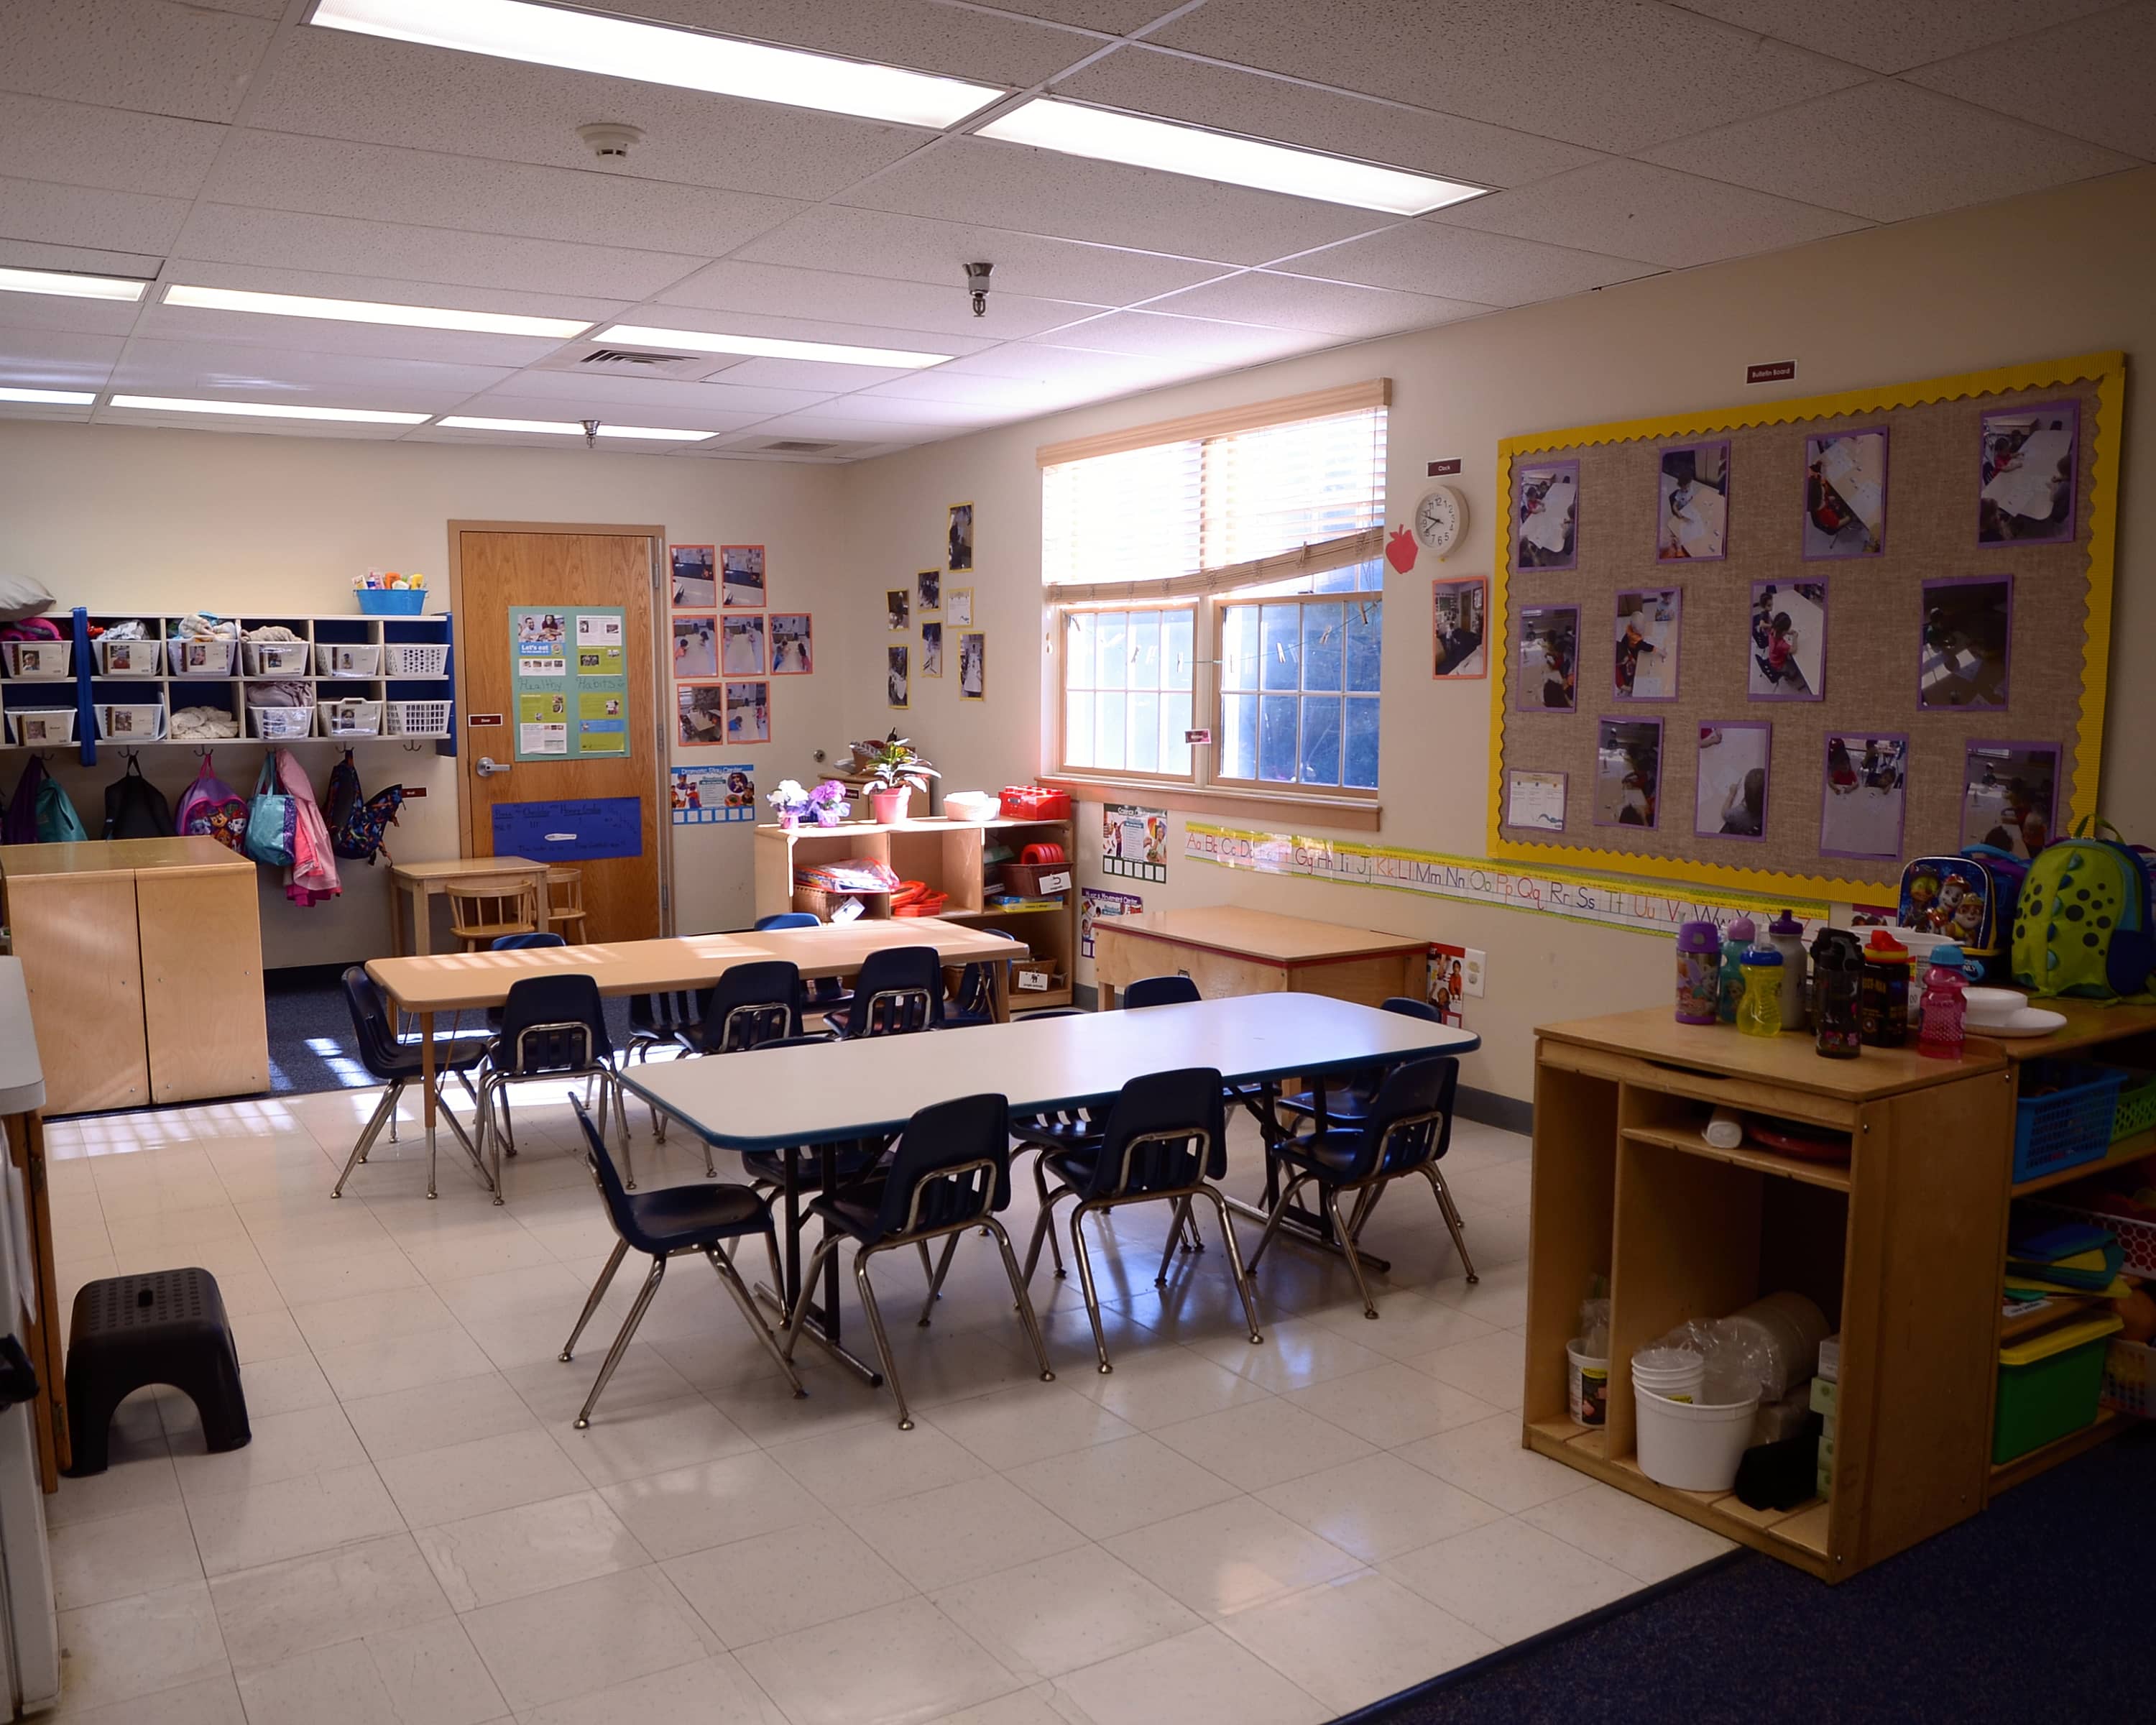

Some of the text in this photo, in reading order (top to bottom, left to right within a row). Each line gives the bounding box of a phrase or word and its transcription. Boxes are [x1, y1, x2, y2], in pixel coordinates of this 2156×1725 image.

[1752, 369, 1772, 378] Bulletin
[1434, 497, 1442, 506] 12
[1437, 536, 1442, 546] 6
[517, 676, 615, 691] Healthy Habits
[1187, 833, 1201, 850] Aa
[1221, 837, 1236, 856] Cc
[1295, 847, 1314, 875] Gg
[1340, 852, 1349, 873] Ii
[1357, 855, 1373, 884] Jj
[1376, 857, 1393, 877] Kk
[1416, 862, 1442, 885] Mm
[1446, 865, 1465, 888] Nn
[1470, 870, 1491, 892] Oo
[1496, 873, 1513, 904] Pp
[1517, 877, 1544, 911] Qq
[1550, 881, 1570, 904] Rr
[1576, 886, 1595, 909] Ss
[1605, 890, 1623, 914] Tt
[1634, 895, 1655, 919] Uu
[1101, 893, 1123, 903] Movement
